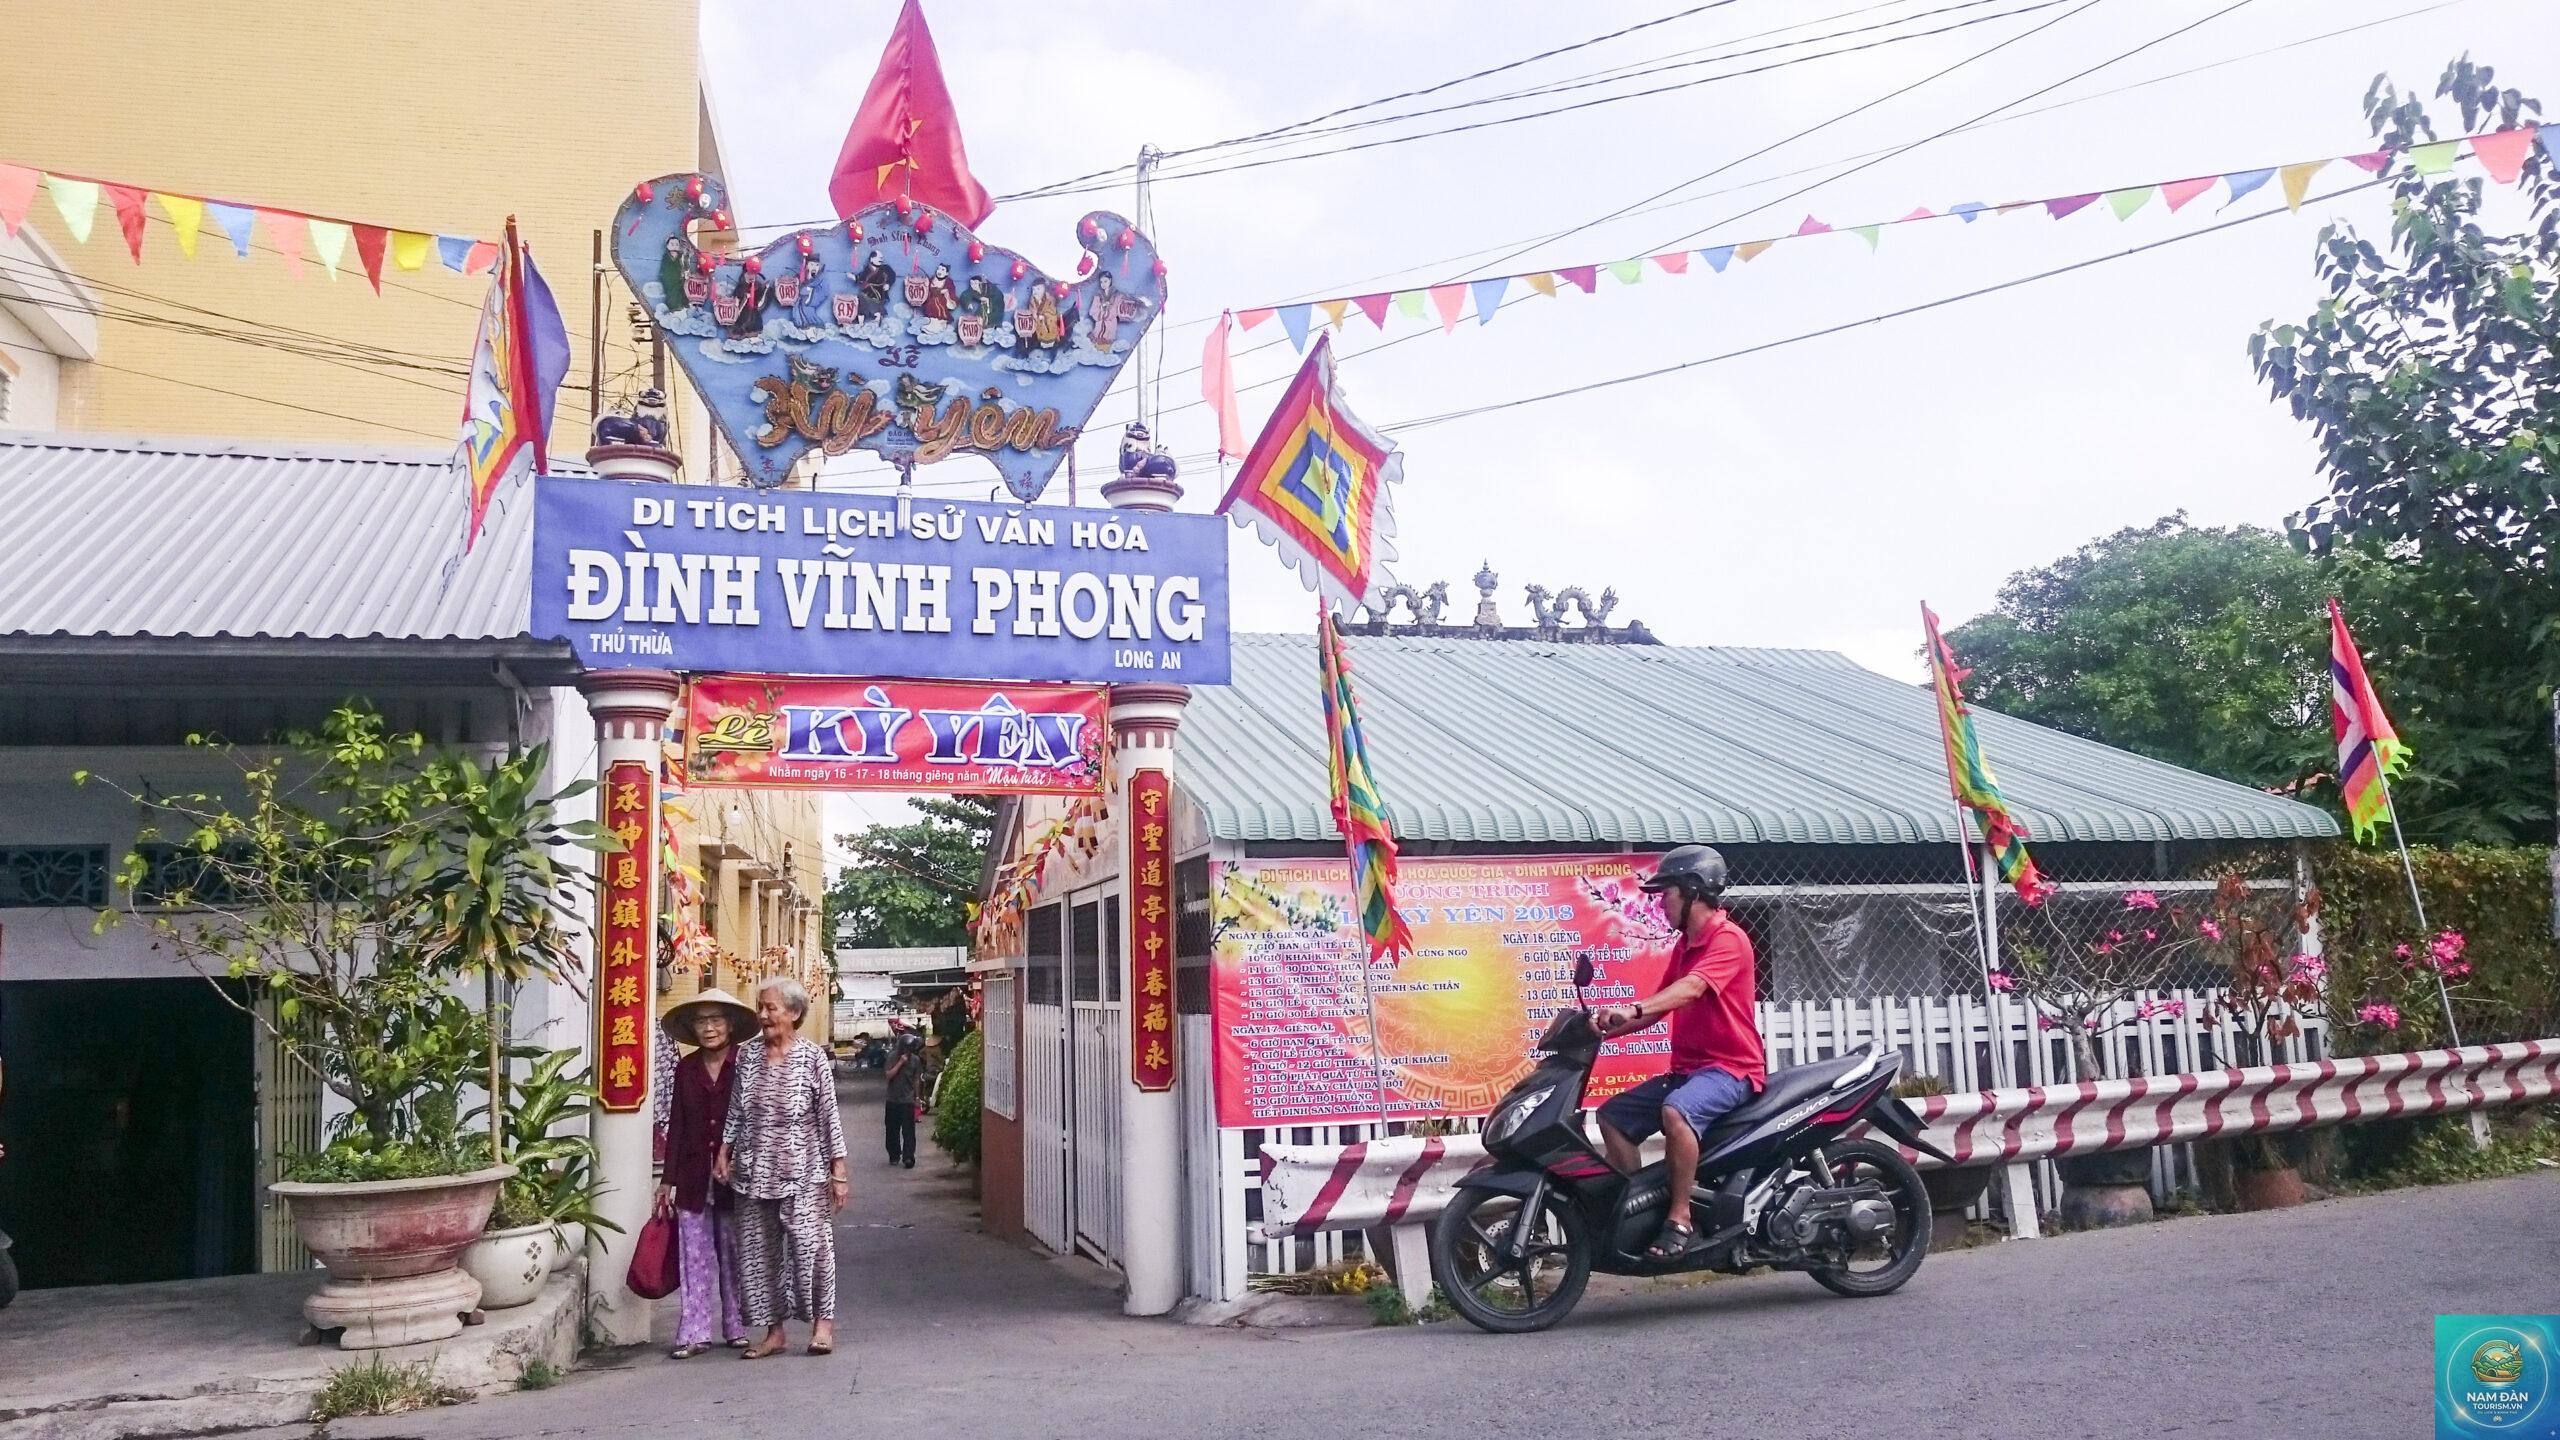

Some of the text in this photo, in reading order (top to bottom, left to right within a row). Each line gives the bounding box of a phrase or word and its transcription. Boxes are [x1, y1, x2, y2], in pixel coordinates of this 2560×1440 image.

[633, 496, 1150, 551] DI TÍCH LỊCH SỬ VĂN HÓA
[567, 530, 1206, 643] ĐÌNH VĨNH PHONG
[589, 626, 674, 655] THỦ THỪA
[1114, 649, 1182, 671] LONG AN
[697, 685, 1087, 769] Lễ KỲ YÊN
[804, 767, 831, 781] ngày
[834, 768, 847, 779] 16
[856, 768, 869, 779] 17
[878, 769, 890, 780] 18
[892, 769, 922, 783] tháng
[925, 770, 955, 784] giêng
[957, 771, 980, 782] năm
[1260, 869, 1276, 883] DI
[1481, 865, 1505, 879] GIA
[1587, 863, 1632, 876] PHONG
[1443, 903, 1574, 922] YÊN 2018
[1502, 930, 1529, 944] NGÀY
[1549, 930, 1580, 943] GIÊNG
[1278, 942, 1299, 950] BAN
[1285, 953, 1312, 961] KHAI
[1314, 952, 1340, 961] KINH
[1524, 952, 1530, 963] 6
[1533, 950, 1550, 963] GIỜ
[1553, 951, 1572, 962] BAN
[1525, 971, 1532, 982] 9
[1534, 968, 1551, 981] GIỜ
[1528, 989, 1539, 1000] 13
[1541, 987, 1558, 999] GIỜ
[1583, 985, 1601, 1002] BỘI
[1529, 1028, 1541, 1040] 18
[1250, 1040, 1258, 1048] 6
[1282, 1038, 1304, 1047] BAN
